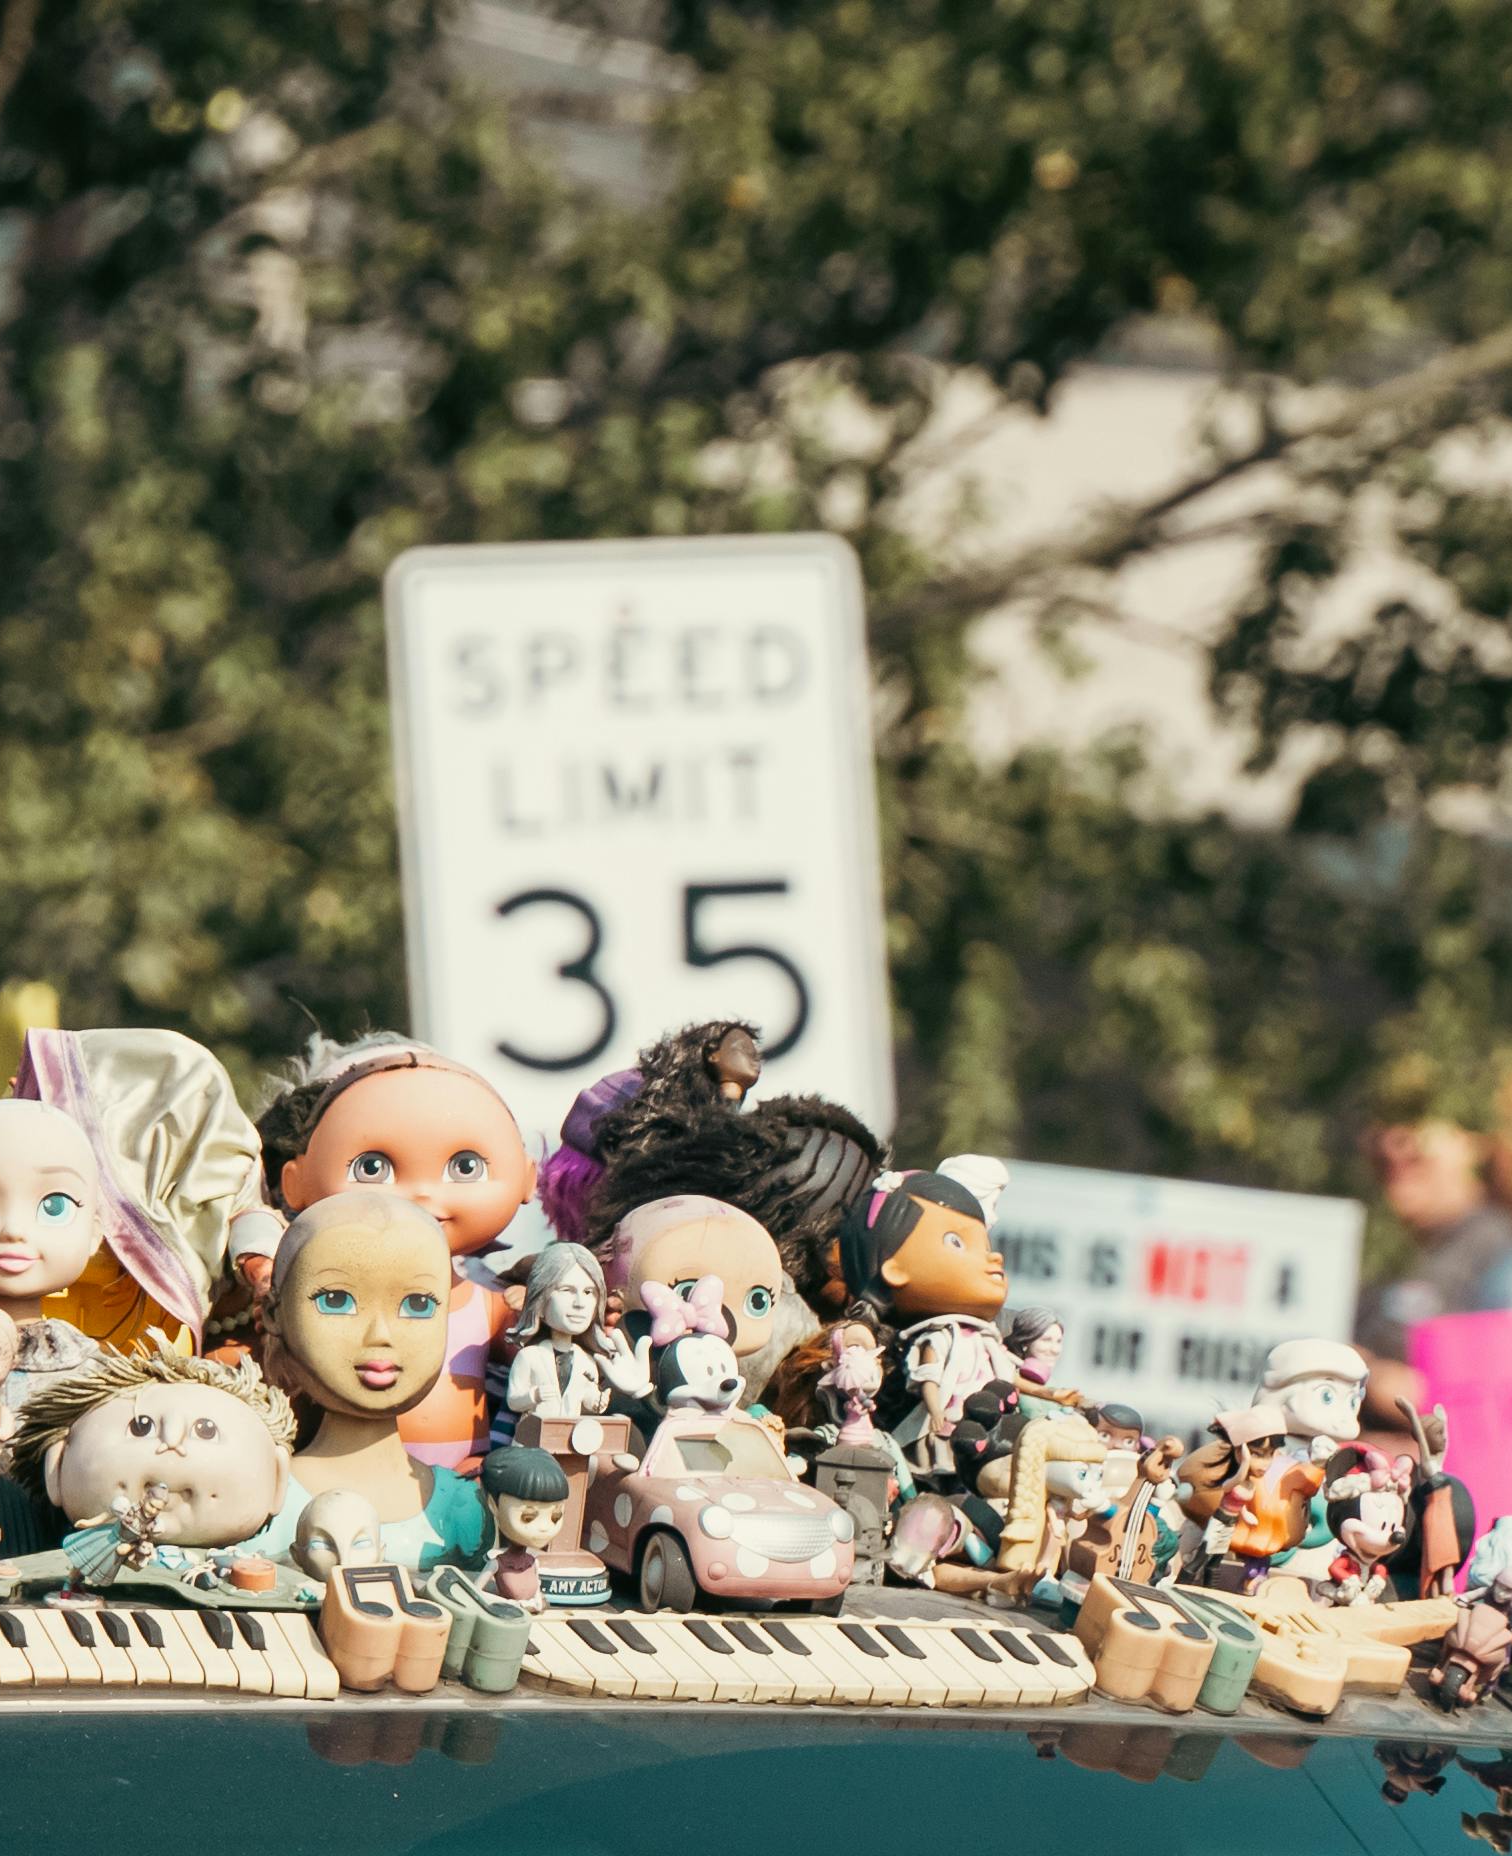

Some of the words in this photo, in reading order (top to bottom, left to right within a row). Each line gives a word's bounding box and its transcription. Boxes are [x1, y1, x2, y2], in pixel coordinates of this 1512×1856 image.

[449, 628, 808, 717] SPEED
[490, 748, 765, 836] LIMIT
[496, 881, 808, 1071] 35
[1150, 1244, 1250, 1302] NOT
[549, 1580, 576, 1593] AMY
[579, 1579, 607, 1593] ACTO
